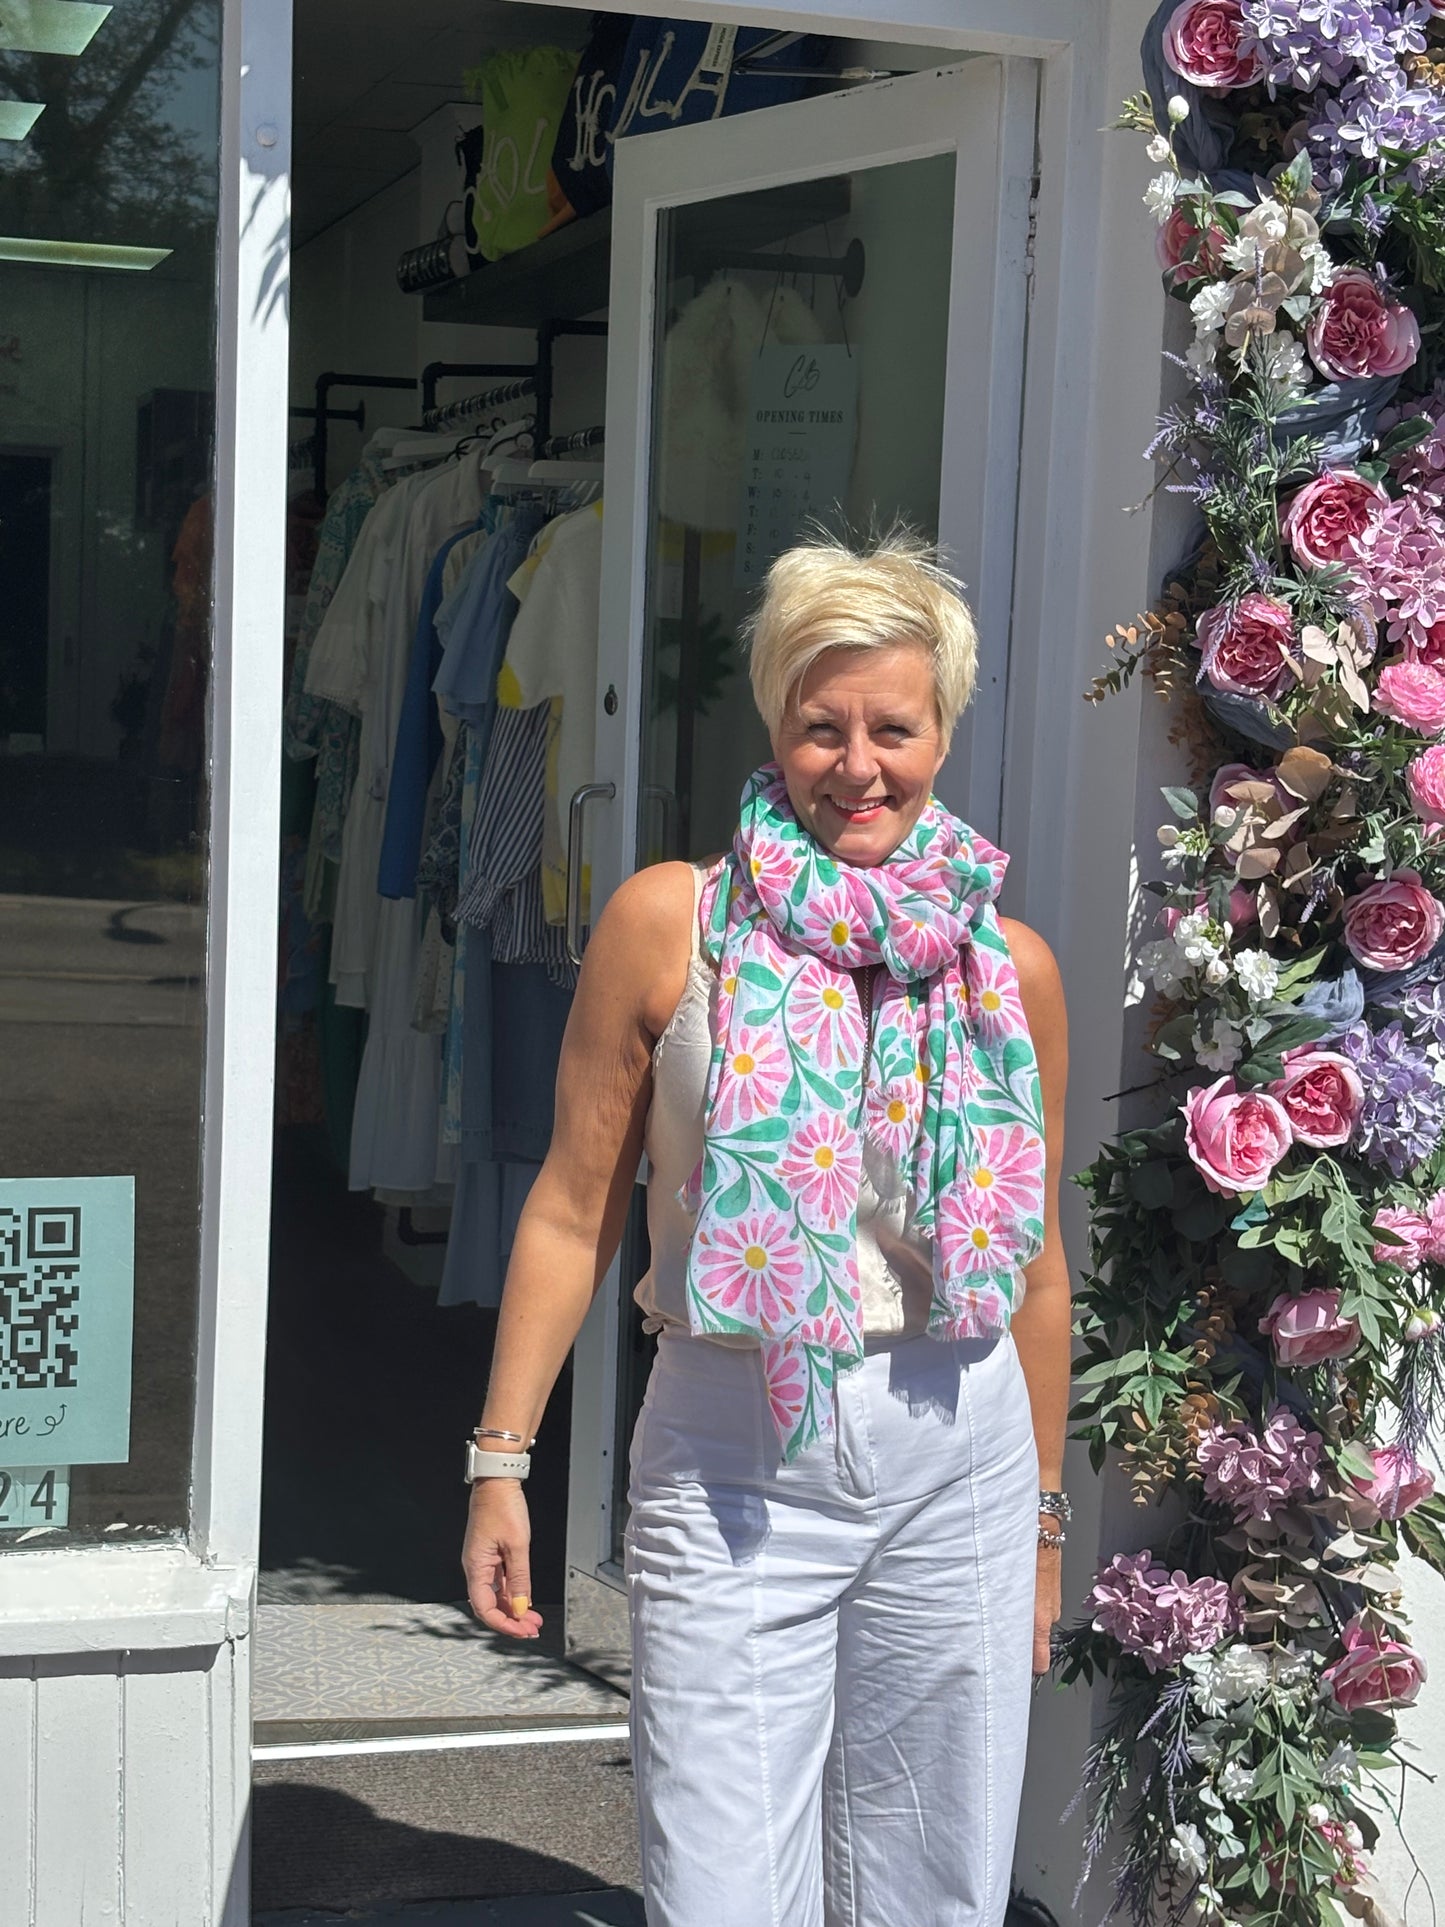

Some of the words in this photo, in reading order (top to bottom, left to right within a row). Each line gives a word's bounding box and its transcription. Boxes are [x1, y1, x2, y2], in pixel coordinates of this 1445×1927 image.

[756, 410, 804, 423] OPENING
[808, 410, 843, 423] TIMES
[0, 1416, 31, 1438] re
